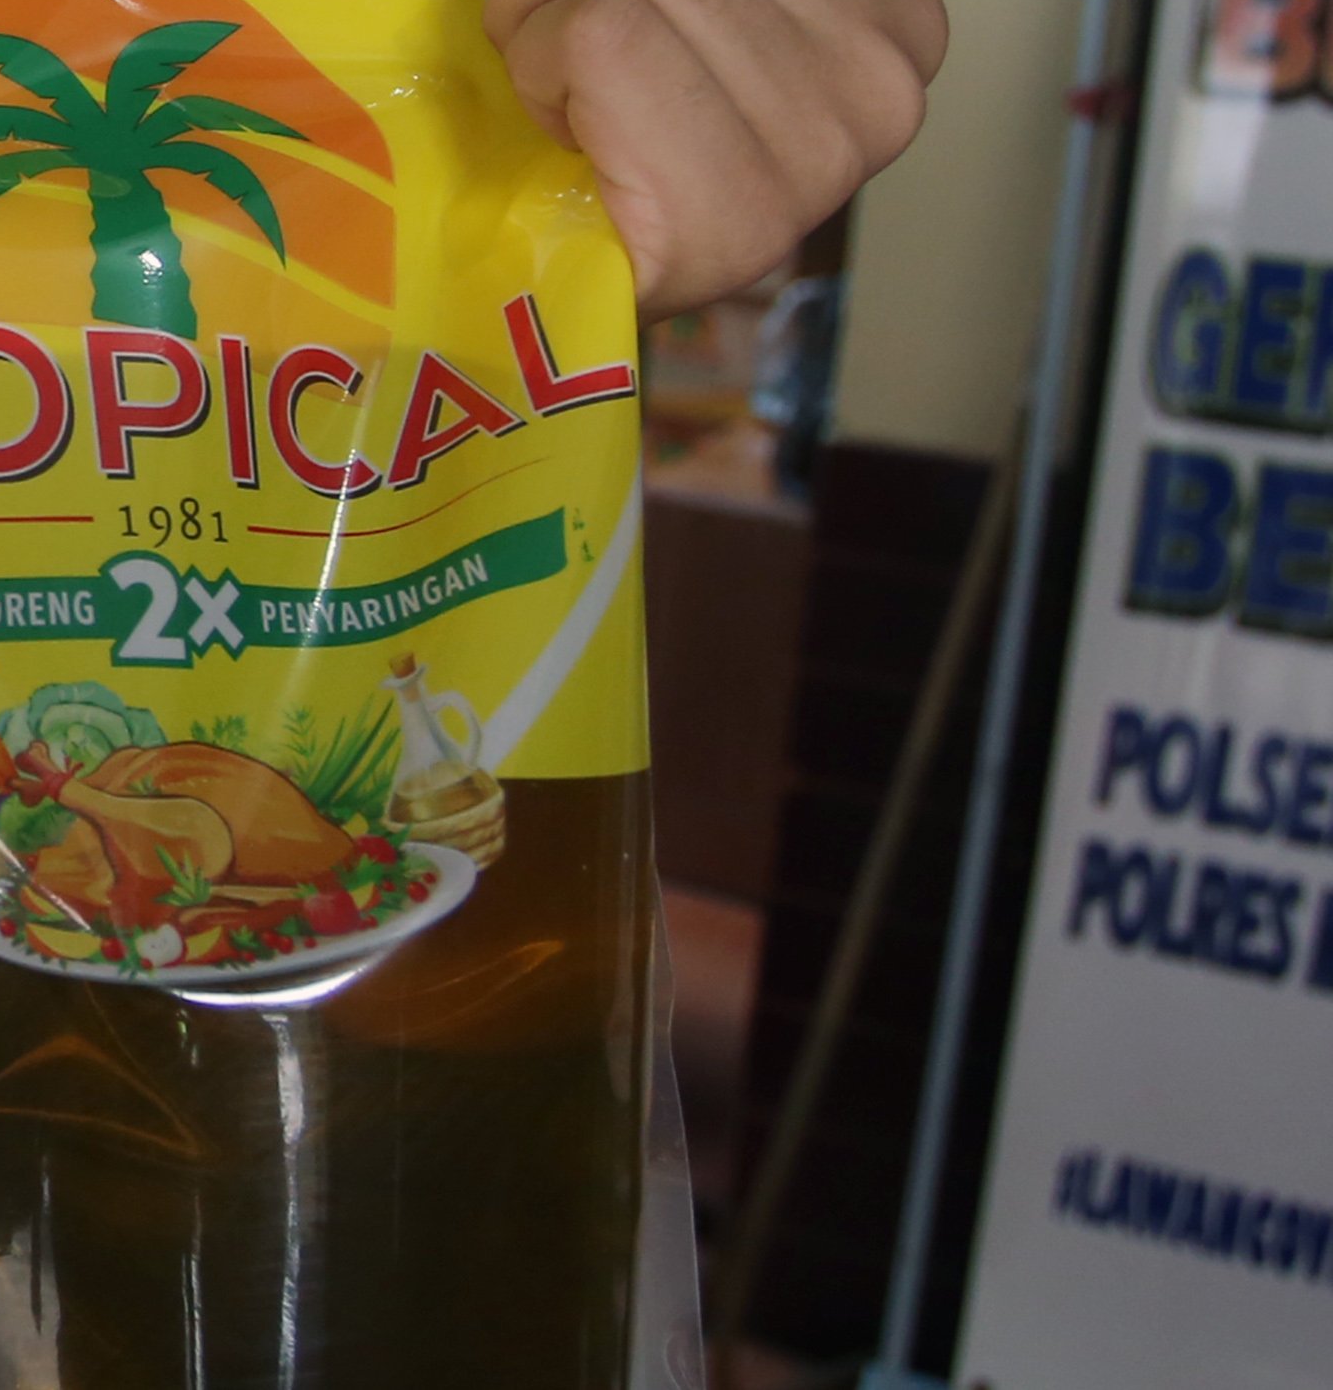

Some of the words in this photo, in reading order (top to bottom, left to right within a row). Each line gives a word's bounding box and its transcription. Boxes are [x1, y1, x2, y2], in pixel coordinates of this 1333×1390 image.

[118, 496, 230, 548] 1981
[259, 552, 490, 636] PENYARINGAN
[1065, 834, 1300, 980] POLRES
